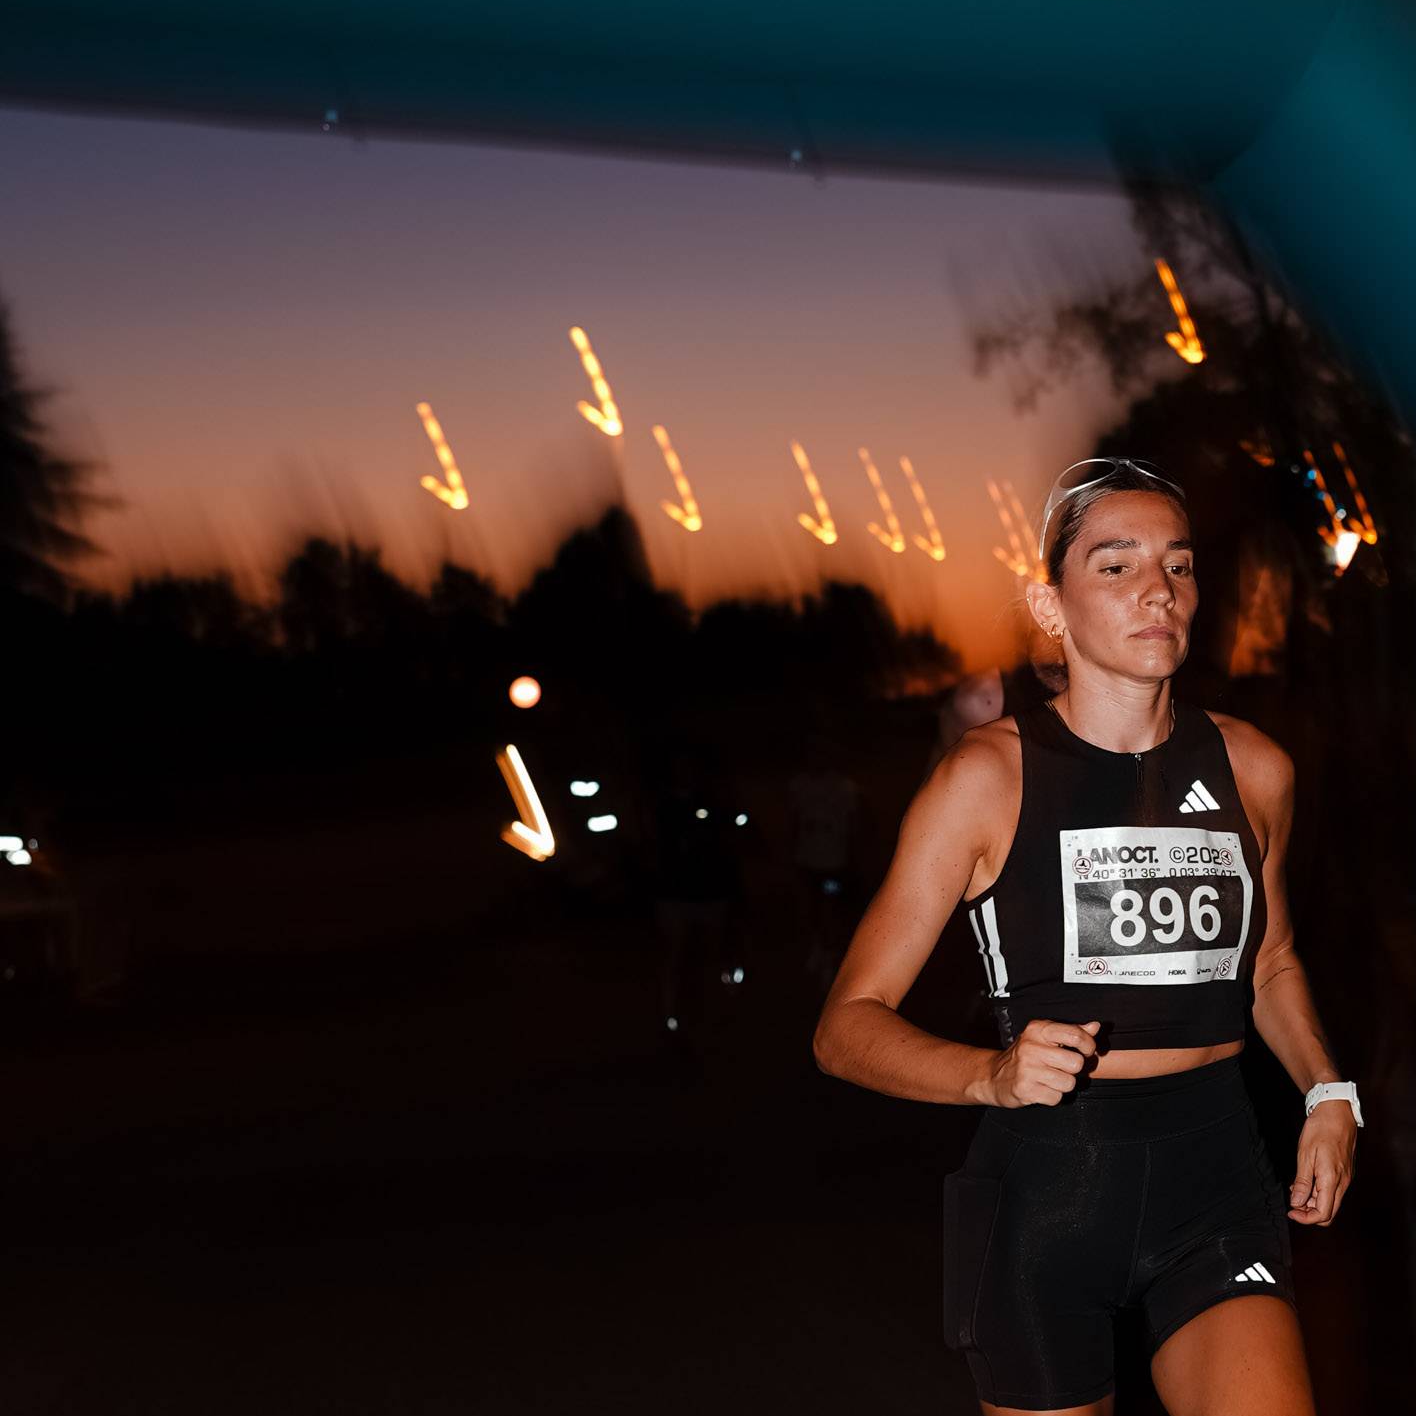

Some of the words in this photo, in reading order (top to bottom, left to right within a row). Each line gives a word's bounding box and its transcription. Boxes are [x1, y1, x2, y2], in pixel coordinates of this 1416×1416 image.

[1169, 846, 1222, 865] ©202
[1092, 867, 1116, 880] 40°
[1110, 885, 1222, 947] 896
[1118, 969, 1157, 977] JAECOO
[1167, 969, 1188, 977] HOKA
